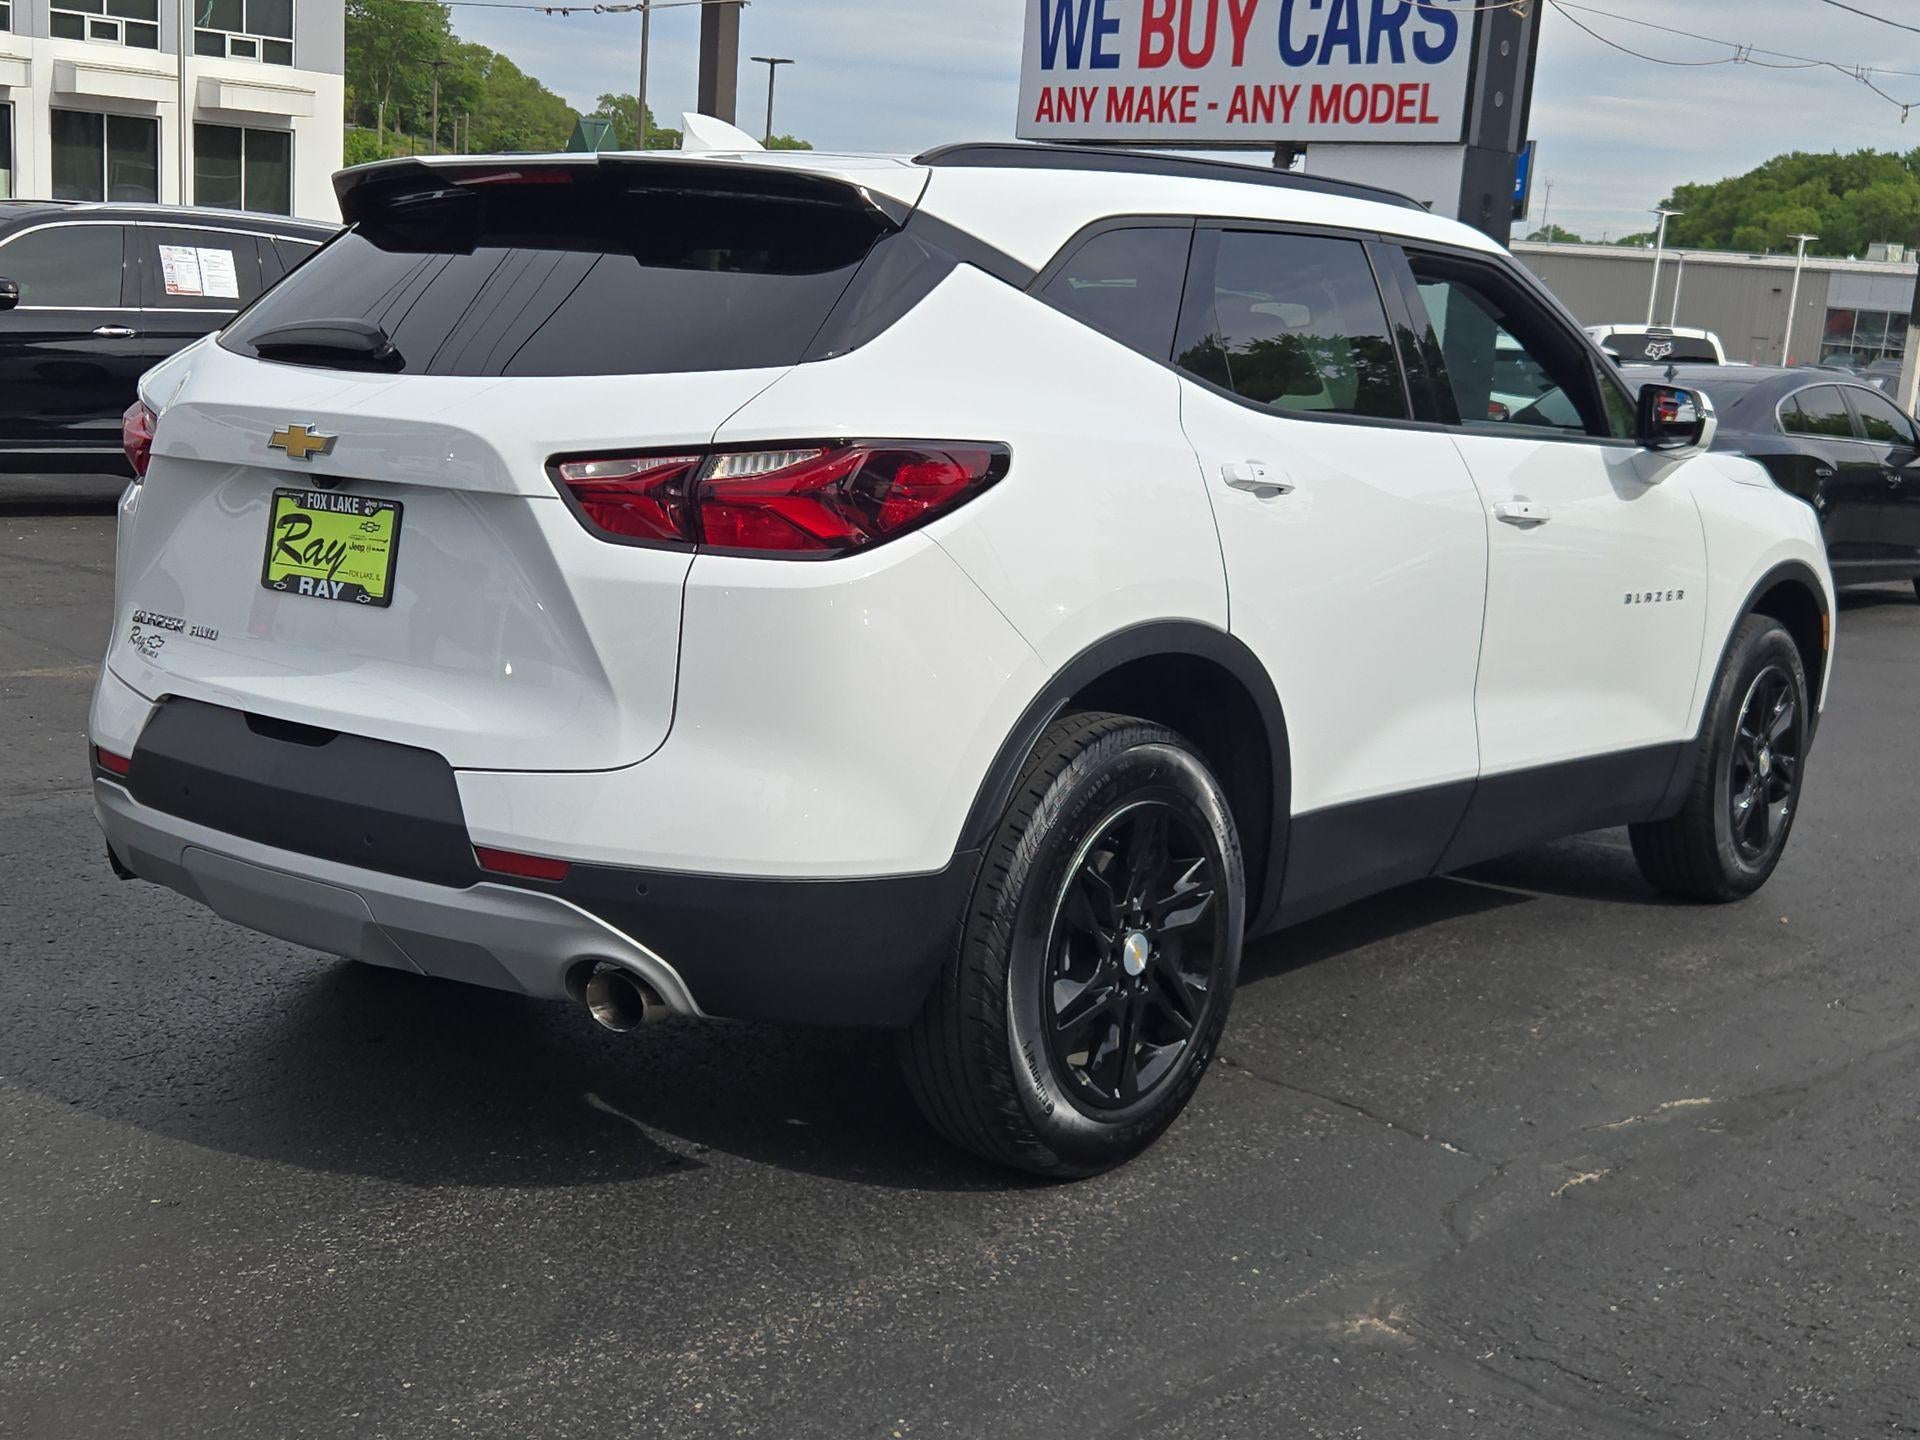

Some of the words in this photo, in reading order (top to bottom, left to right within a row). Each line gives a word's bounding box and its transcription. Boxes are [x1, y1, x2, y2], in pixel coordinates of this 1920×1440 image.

[1040, 0, 1121, 70] WE
[1138, 0, 1259, 69] BUY
[1278, 0, 1458, 67] CARS
[1035, 86, 1099, 123] ANY
[1105, 85, 1199, 123] MAKE
[1226, 84, 1301, 123] ANY
[1308, 83, 1439, 124] MODEL
[307, 492, 327, 510] FOX
[331, 494, 359, 514] LAKE
[272, 513, 347, 579] Ray
[299, 576, 345, 600] RAY
[1624, 589, 1684, 605] BLAZER
